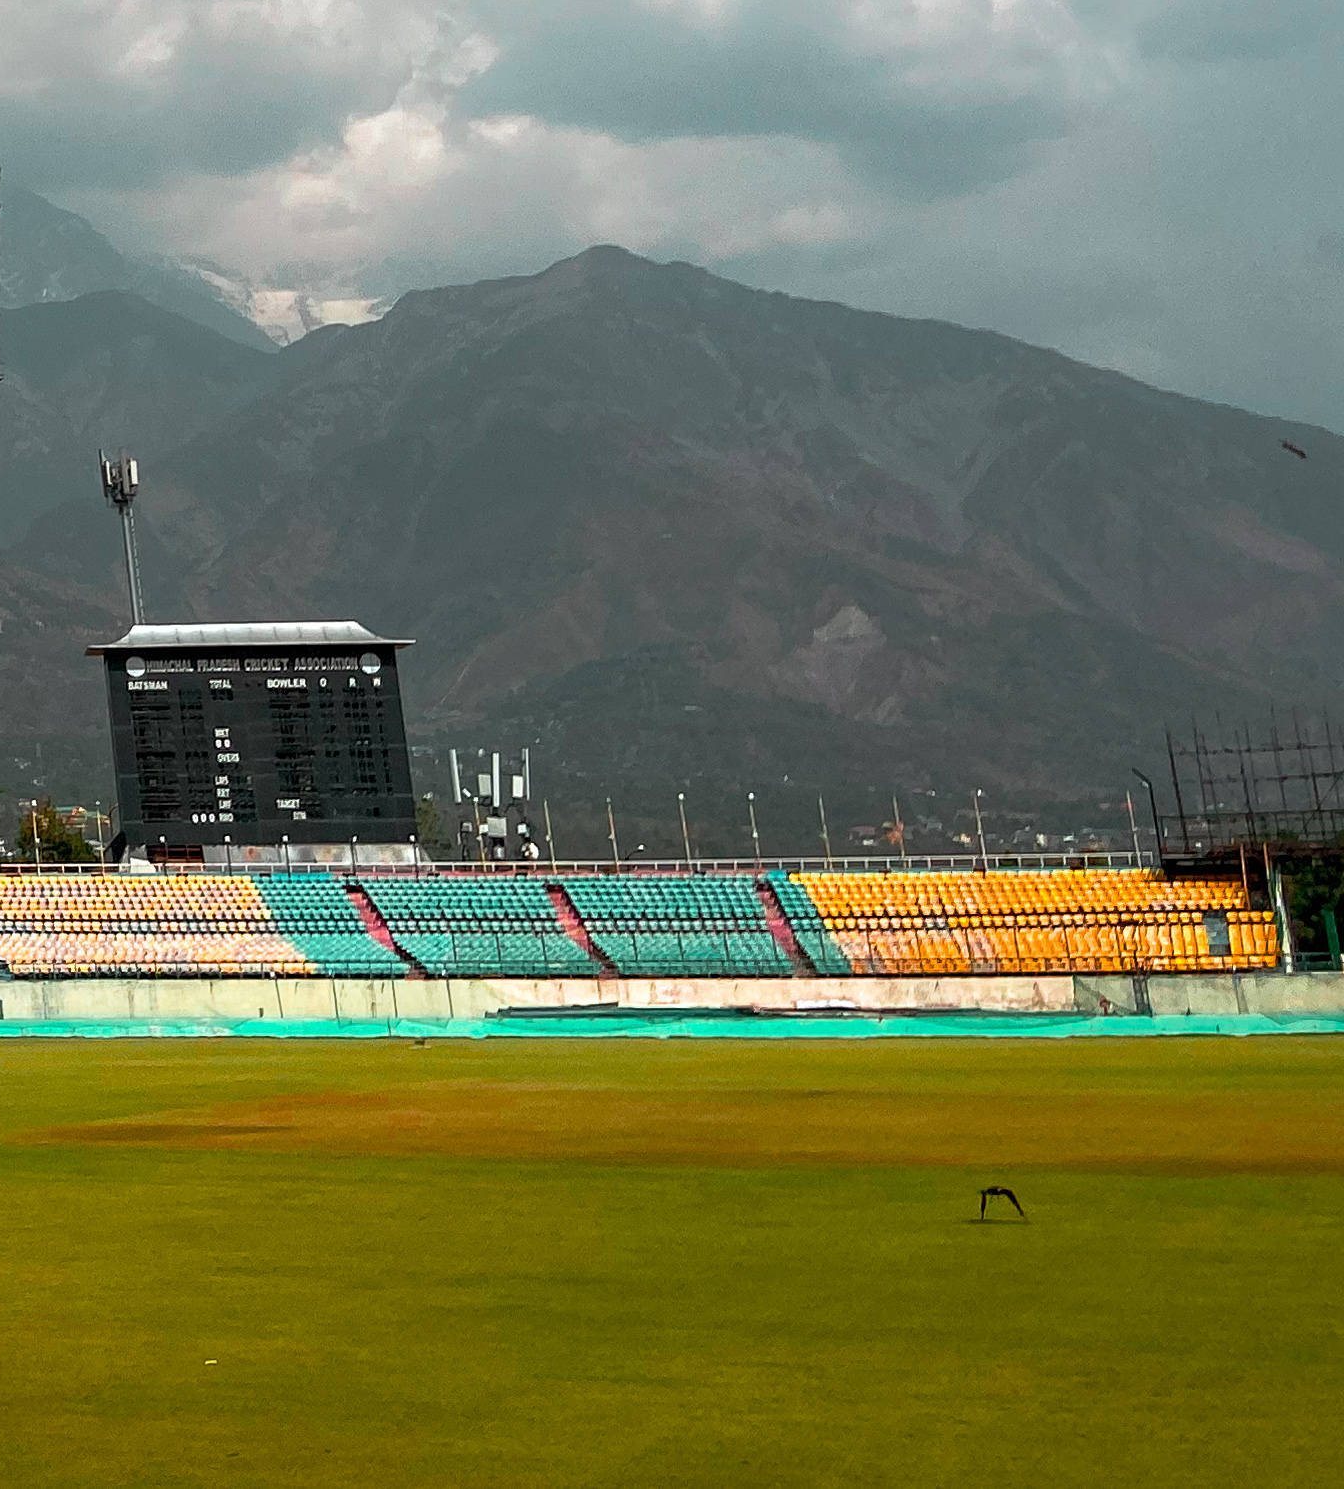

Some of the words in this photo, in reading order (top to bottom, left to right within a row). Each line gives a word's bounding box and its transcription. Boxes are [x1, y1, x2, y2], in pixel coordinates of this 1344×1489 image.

[146, 660, 194, 672] HIMACHAL
[197, 659, 240, 671] PRADESH
[244, 658, 289, 671] CRICKET
[294, 657, 358, 670] ASSOCIATION
[128, 681, 168, 690] BATSMAN
[209, 679, 231, 689] TOTAL
[267, 678, 306, 688] BOWLER
